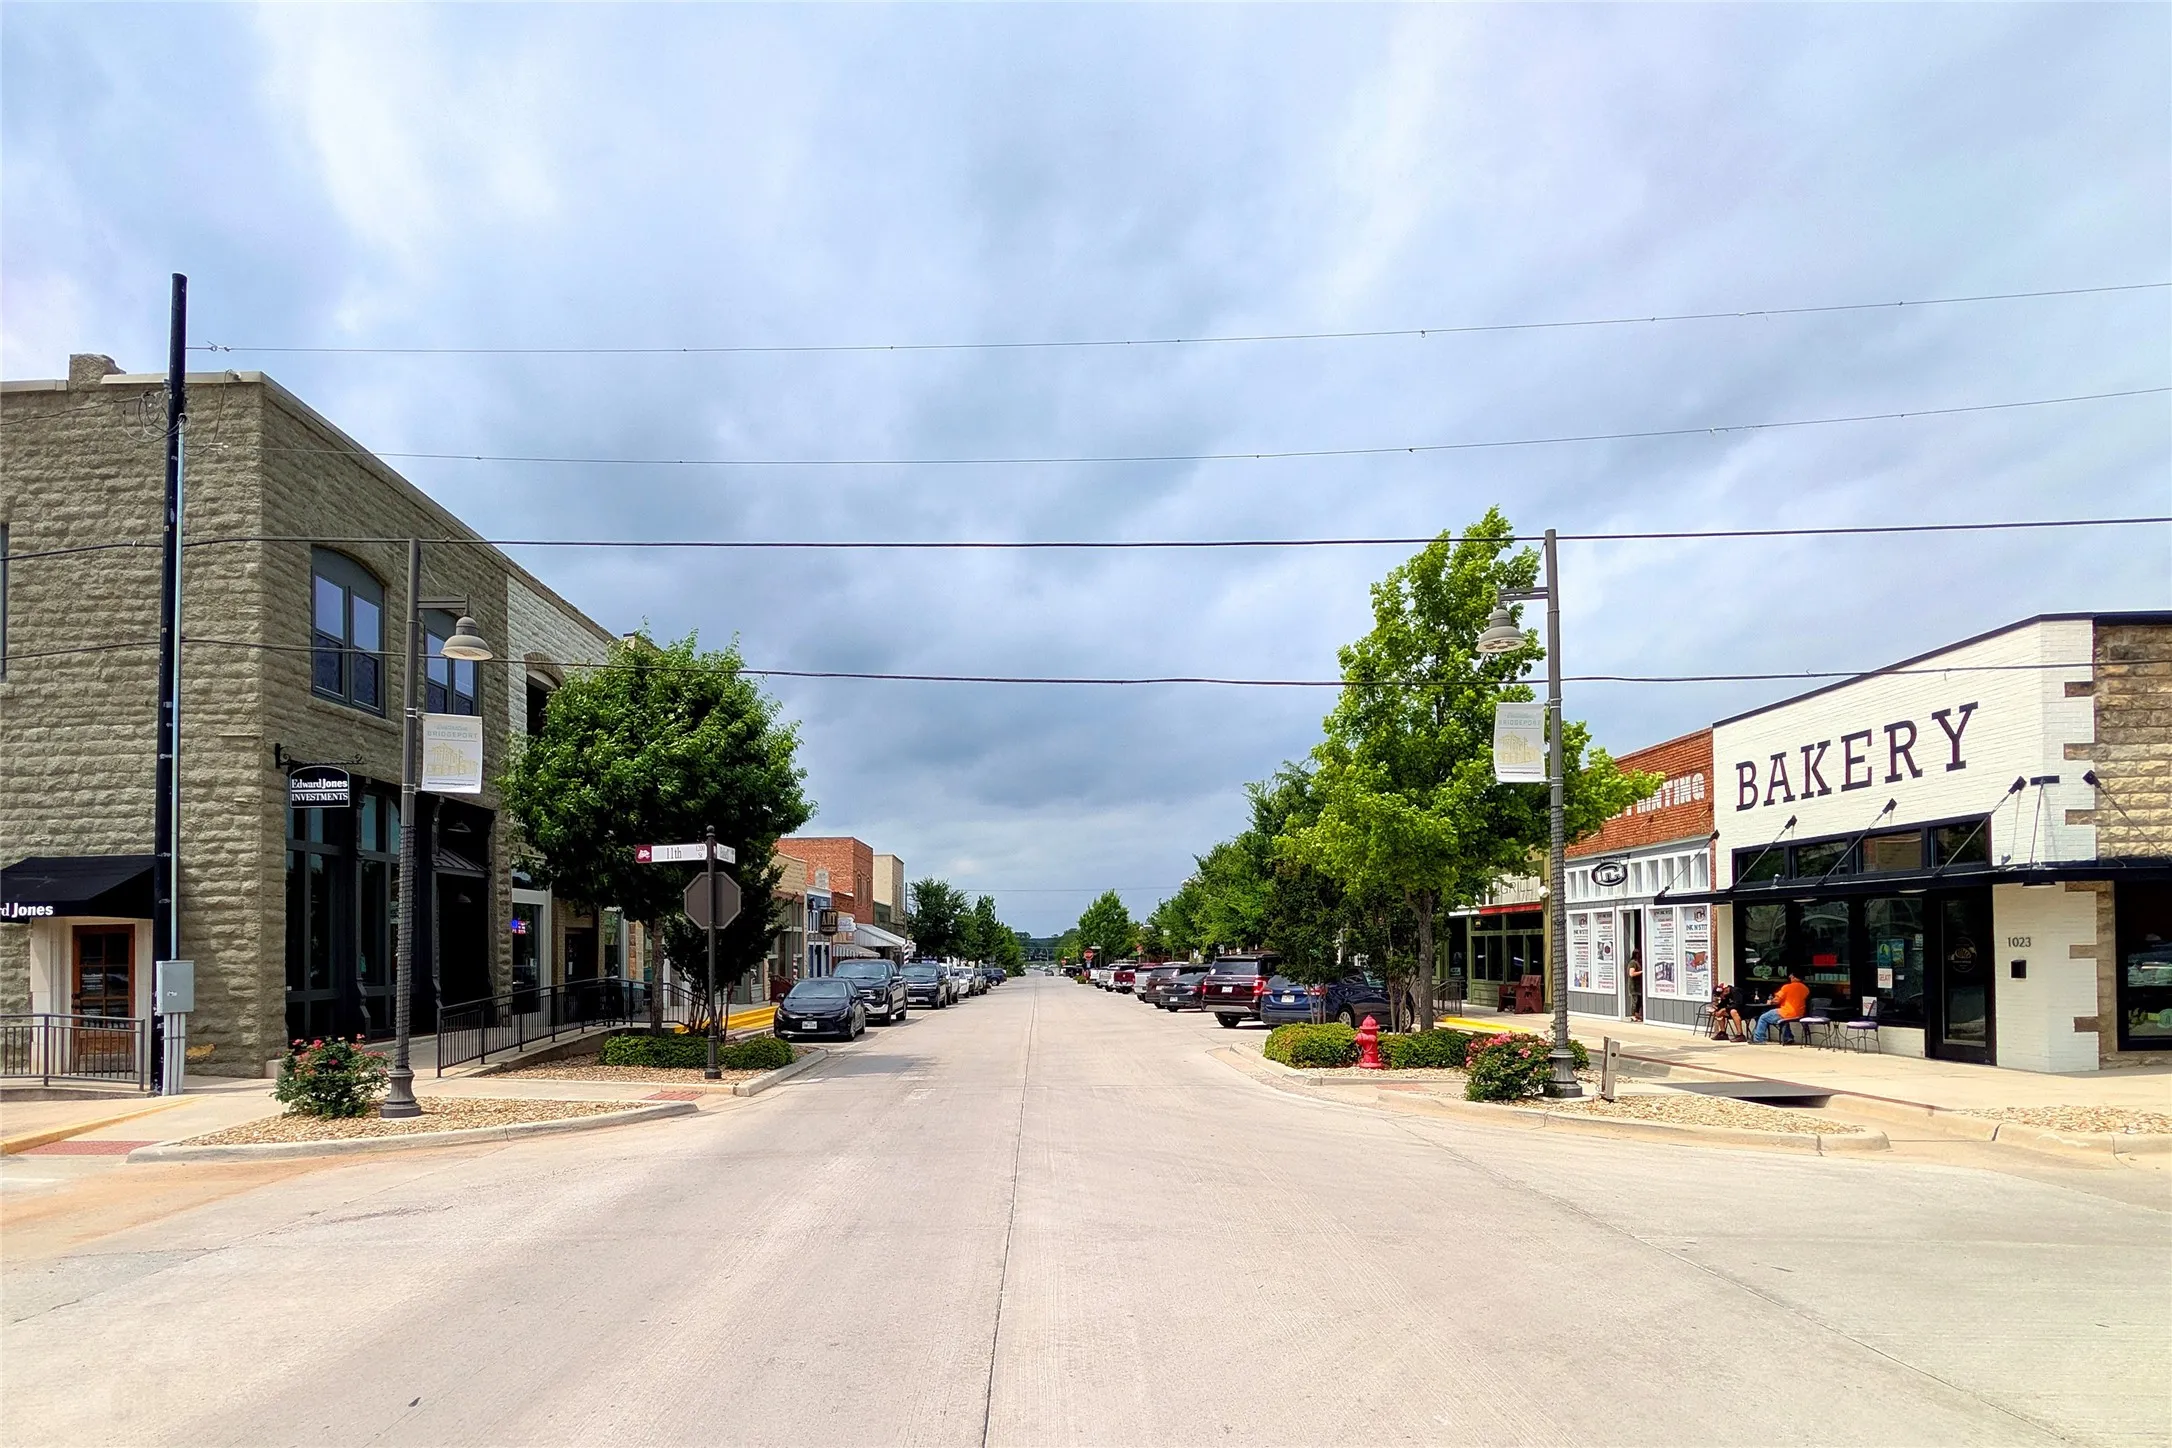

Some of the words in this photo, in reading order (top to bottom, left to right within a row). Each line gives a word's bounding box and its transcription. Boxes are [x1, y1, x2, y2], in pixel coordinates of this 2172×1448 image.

[427, 730, 478, 739] BRIDGEPORT
[1736, 701, 1979, 811] BAKERY
[291, 793, 348, 801] INVESTMENTS
[666, 847, 683, 859] 11th
[1500, 880, 1533, 895] GRILL
[11, 902, 54, 918] Jones
[821, 911, 837, 925] ART
[2007, 937, 2031, 948] 1023
